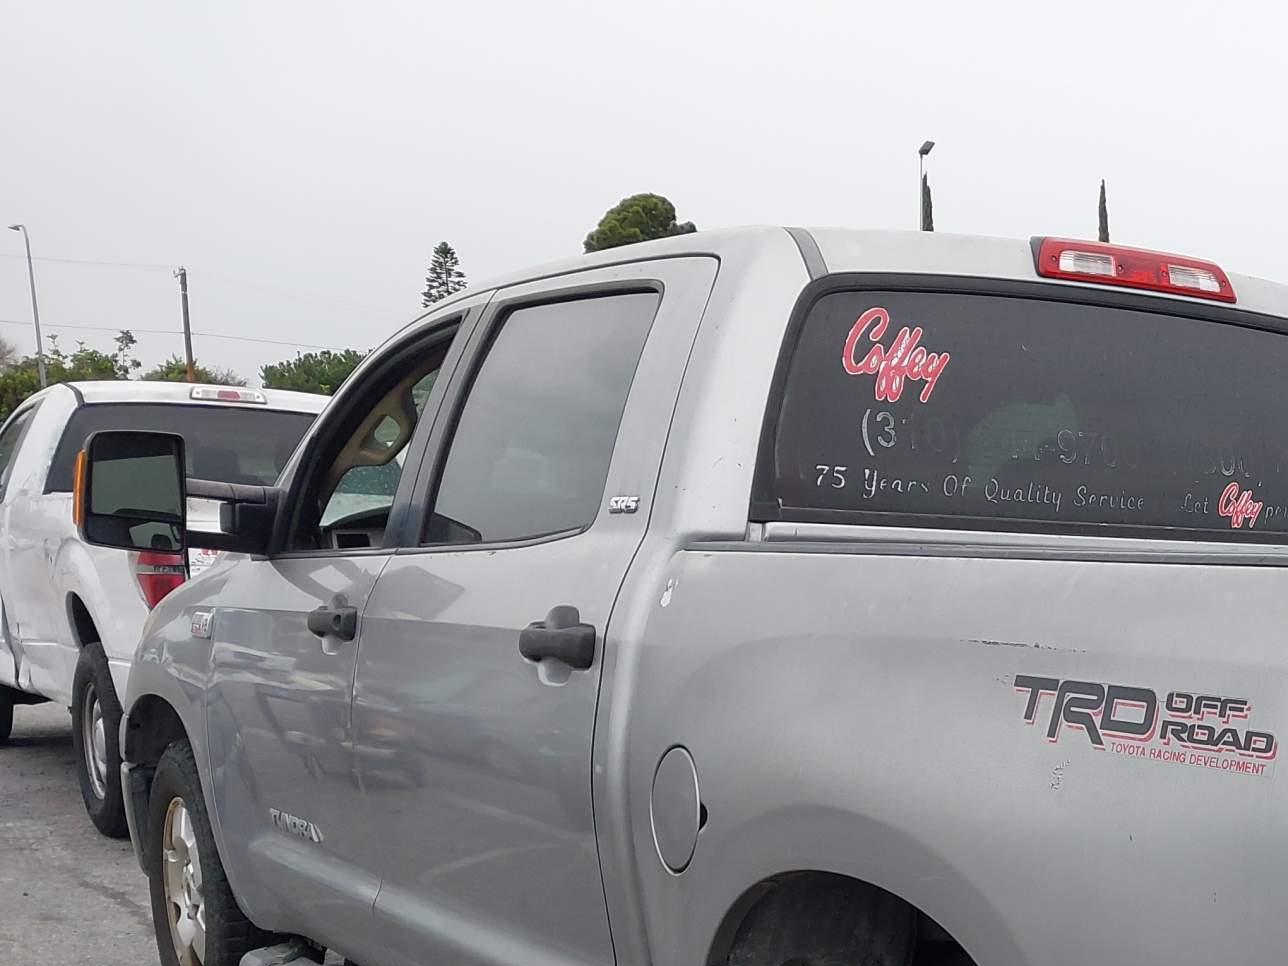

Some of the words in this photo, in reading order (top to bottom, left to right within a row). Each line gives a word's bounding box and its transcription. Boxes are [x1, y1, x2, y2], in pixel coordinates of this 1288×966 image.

[842, 307, 950, 403] Coffey
[816, 465, 848, 489] 75
[943, 474, 972, 497] Of
[985, 478, 1063, 512] Quality
[1073, 486, 1145, 510] Service
[1218, 482, 1263, 528] Coffey
[1014, 675, 1160, 752] TRD
[1165, 692, 1251, 724] OFF
[1110, 742, 1147, 758] TOYOTA
[1149, 750, 1187, 763] RACING
[1189, 756, 1267, 776] DEVELOPMENT
[1159, 720, 1277, 760] ROAD
[269, 807, 324, 843] TUNDRA
